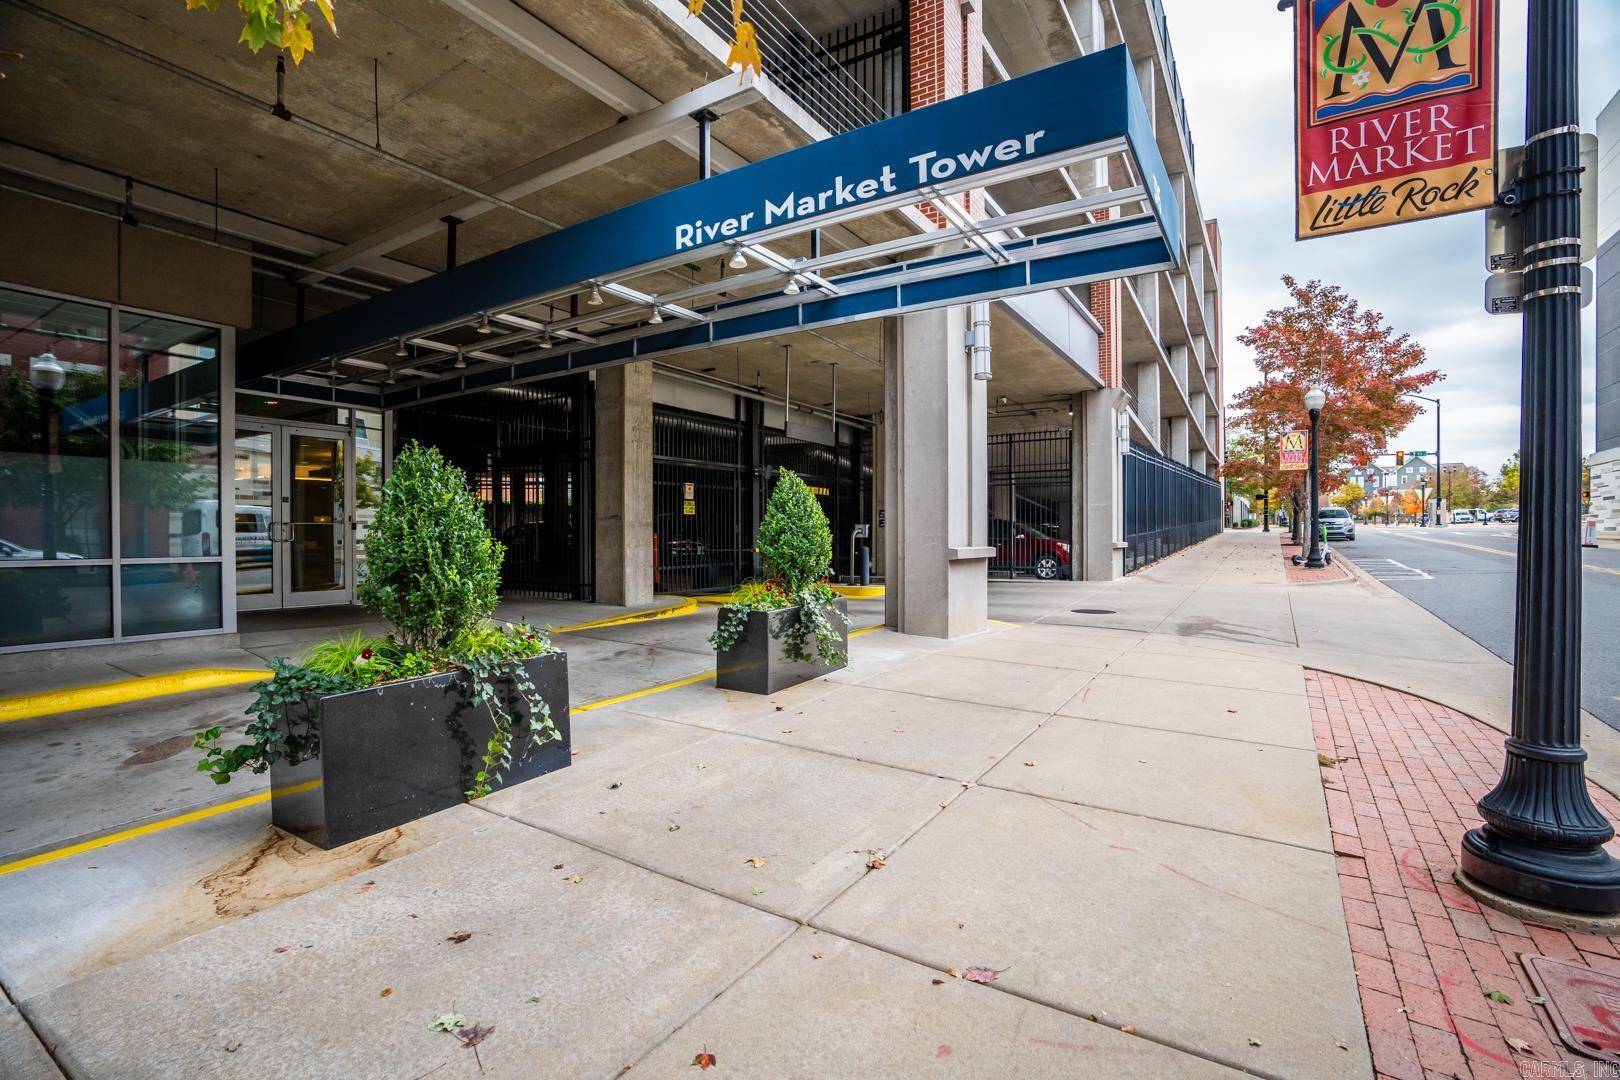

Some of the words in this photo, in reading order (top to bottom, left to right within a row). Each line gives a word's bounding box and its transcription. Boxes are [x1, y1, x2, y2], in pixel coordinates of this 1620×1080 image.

[1307, 125, 1485, 187] MARKET
[1330, 104, 1458, 155] RIVER
[676, 211, 754, 250] River
[765, 173, 897, 225] Market
[908, 130, 1046, 184] Tower
[1309, 185, 1388, 231] Little
[1392, 166, 1480, 216] Rock
